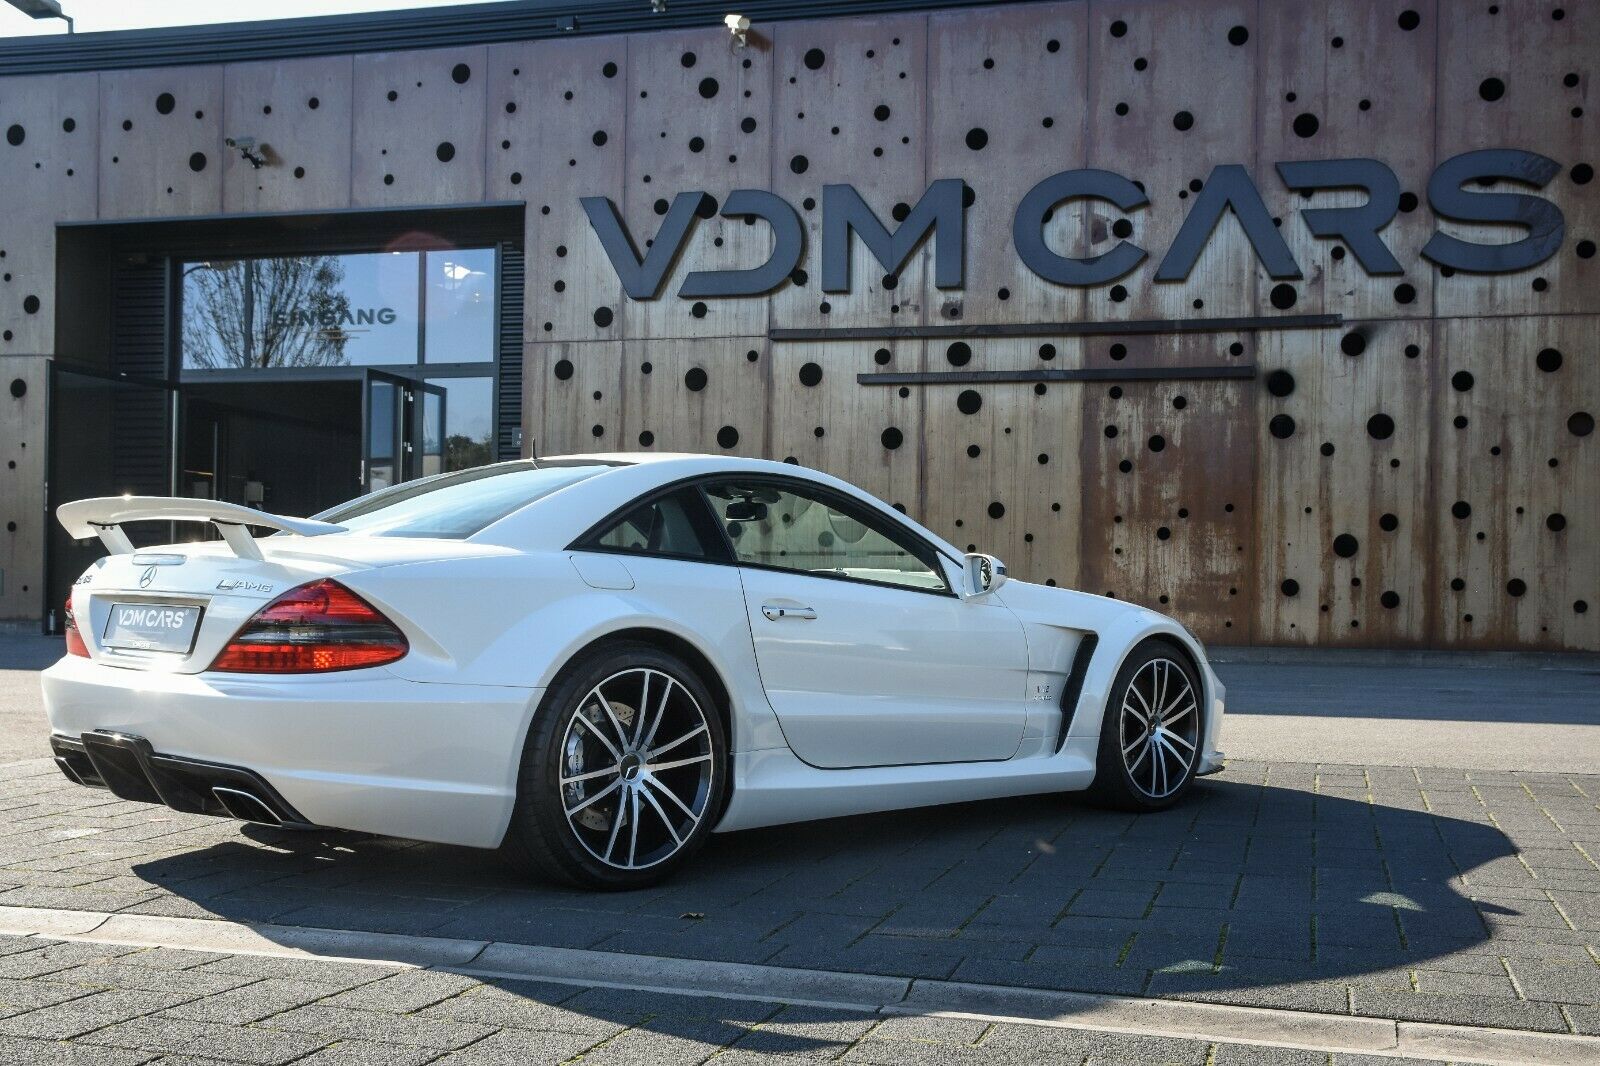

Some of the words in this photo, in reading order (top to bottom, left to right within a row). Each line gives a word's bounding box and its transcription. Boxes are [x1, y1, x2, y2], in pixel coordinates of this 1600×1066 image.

[579, 178, 964, 301] VDM
[1012, 148, 1566, 288] CARS
[272, 307, 397, 327] EINGANG
[234, 580, 273, 592] AMG
[118, 609, 147, 627] VDM
